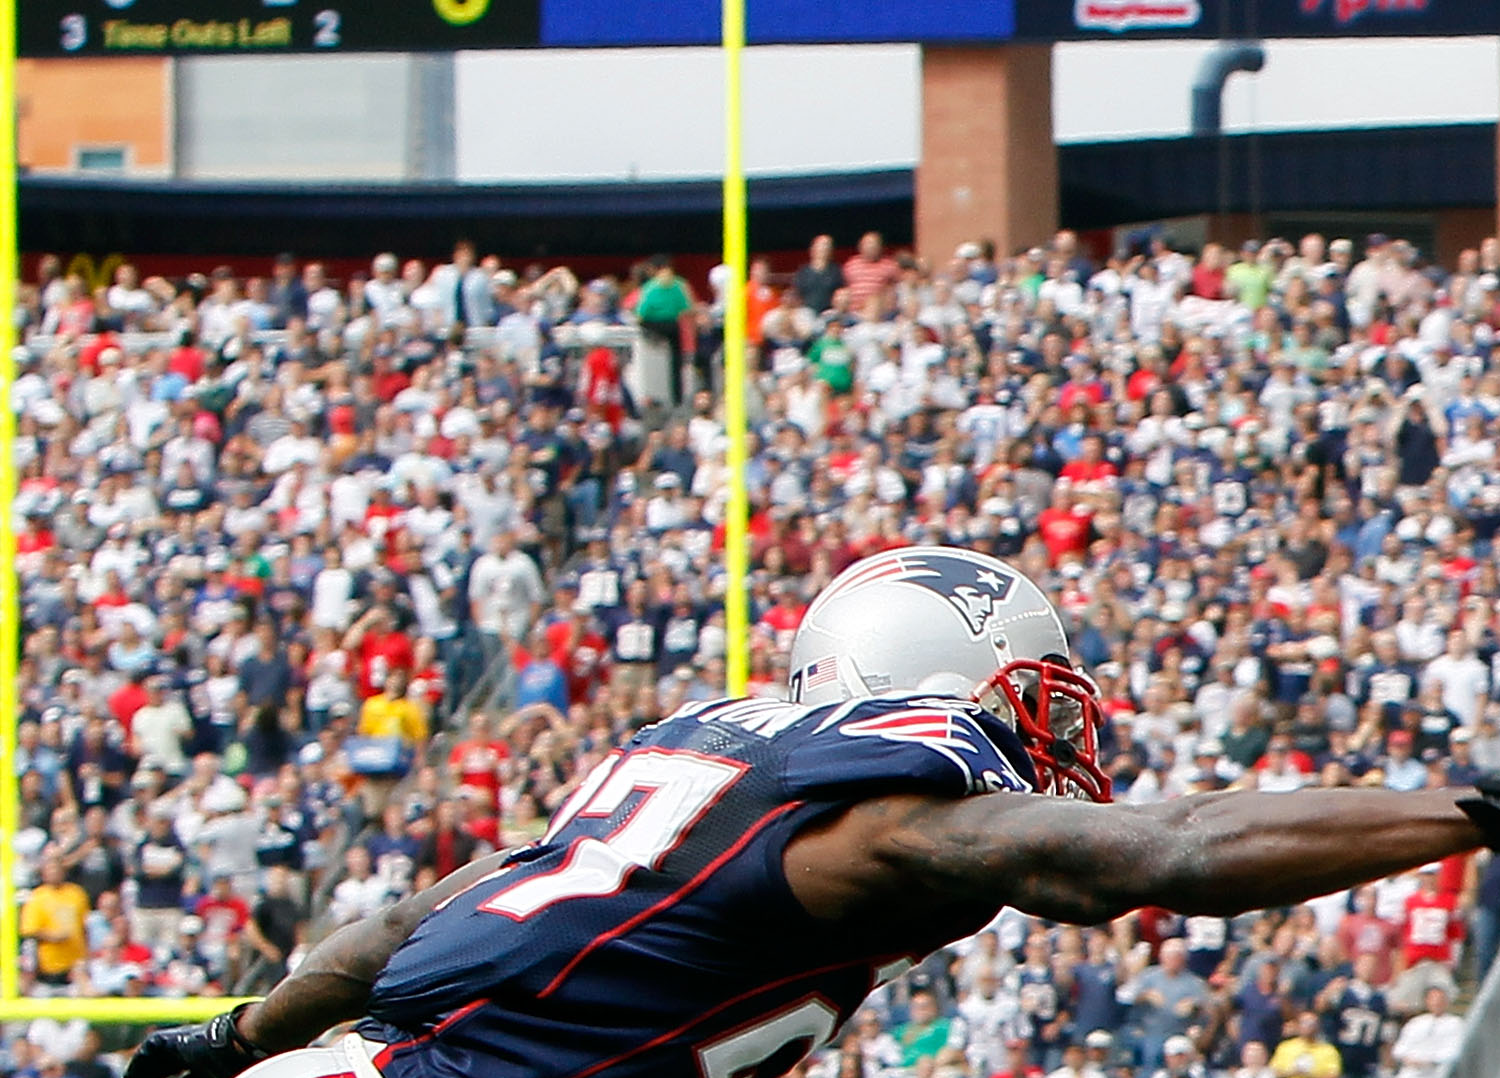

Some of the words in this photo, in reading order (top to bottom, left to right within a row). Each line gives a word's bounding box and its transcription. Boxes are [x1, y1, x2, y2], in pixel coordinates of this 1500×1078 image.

[60, 13, 87, 50] 3
[103, 20, 168, 47] Time
[171, 18, 235, 47] Outs
[238, 17, 291, 47] Left
[314, 9, 341, 47] 2
